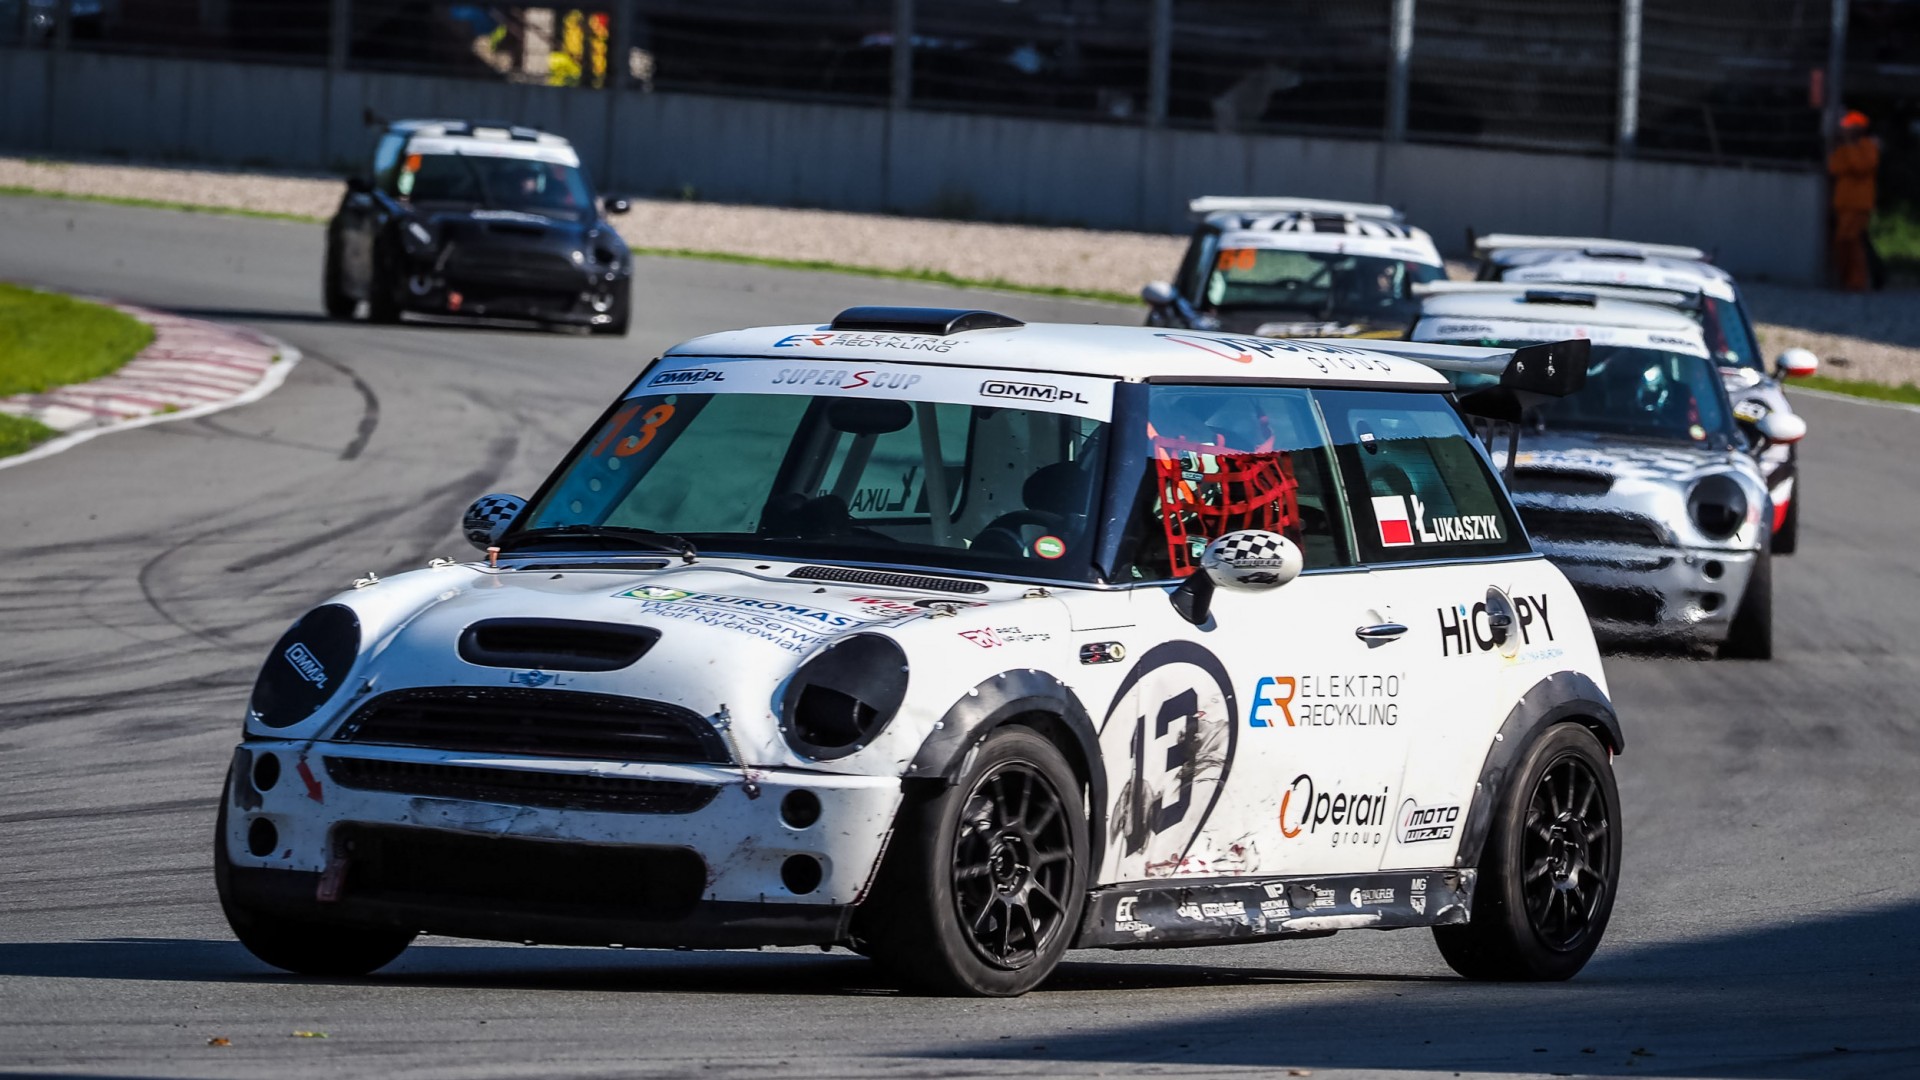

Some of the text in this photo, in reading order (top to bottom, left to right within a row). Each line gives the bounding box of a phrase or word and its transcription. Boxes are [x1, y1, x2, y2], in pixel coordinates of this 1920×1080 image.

[830, 339, 952, 353] RECYKLING
[772, 368, 848, 386] SUPER
[871, 372, 923, 390] CUP
[986, 383, 1090, 405] OMM.PL
[592, 403, 676, 457] 13
[1437, 593, 1555, 657] HiCPY
[1300, 675, 1400, 698] ELEKTRO
[1299, 703, 1399, 727] RECYKLING
[1123, 687, 1200, 858] 13
[1409, 806, 1460, 827] MOTO
[1331, 830, 1382, 848] group
[1407, 828, 1454, 842] WIZJA
[1411, 878, 1428, 891] MG
